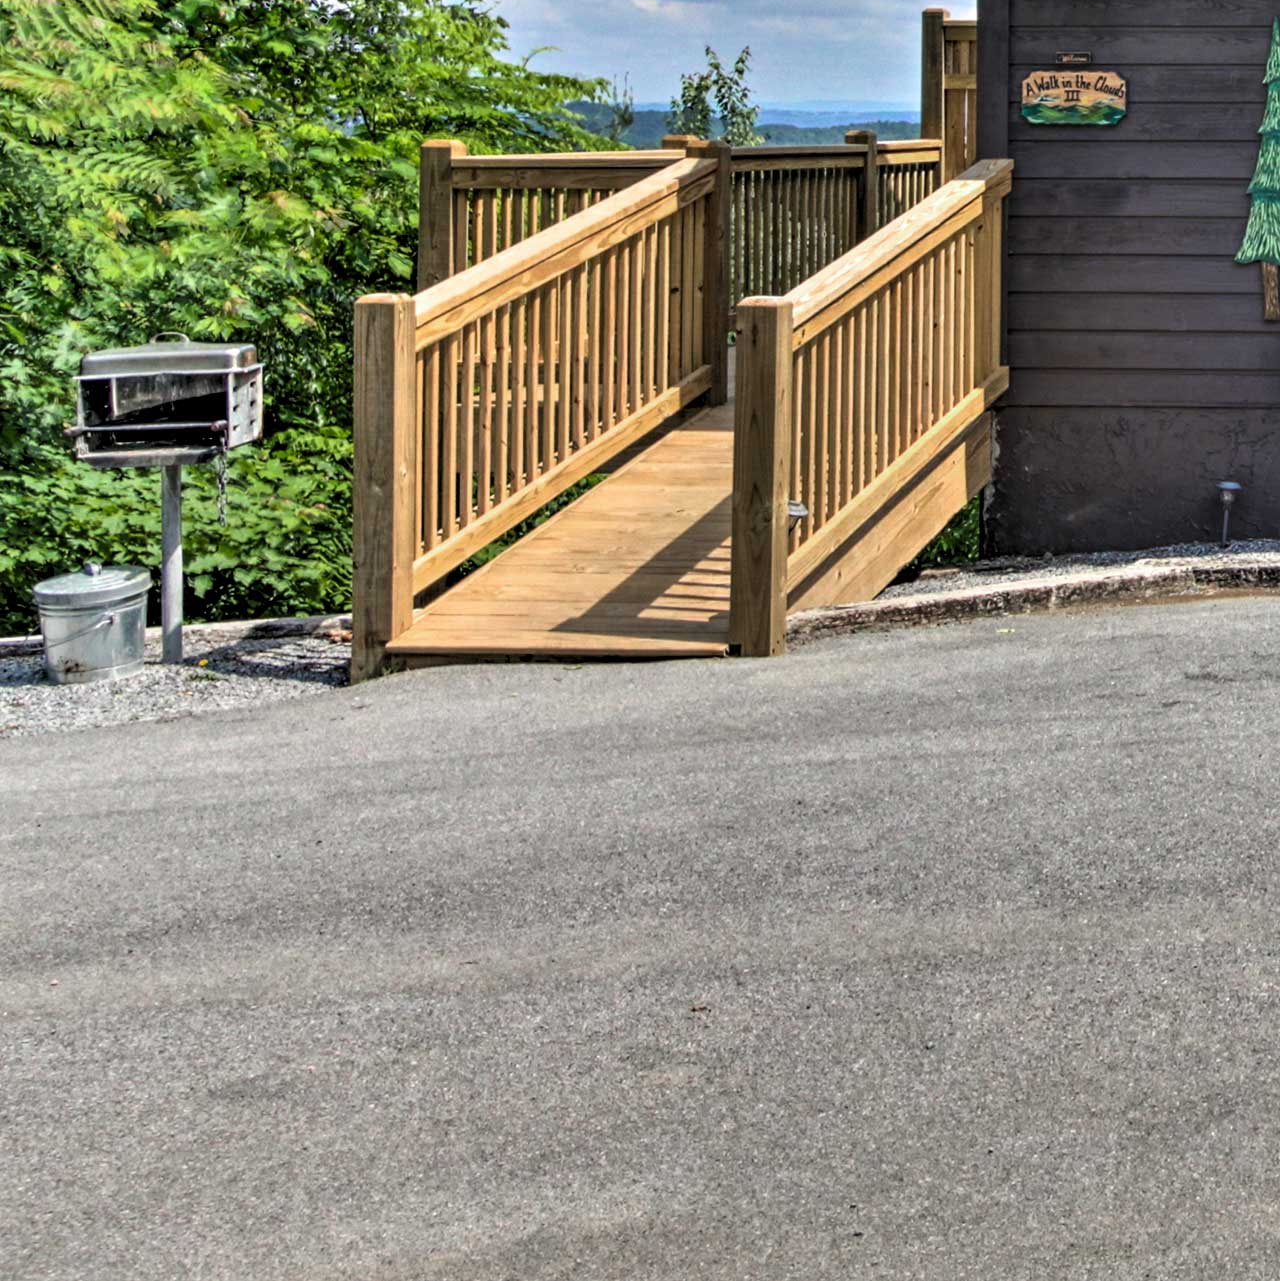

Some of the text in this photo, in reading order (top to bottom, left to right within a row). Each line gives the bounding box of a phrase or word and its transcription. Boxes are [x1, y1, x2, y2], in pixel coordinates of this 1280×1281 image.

[1026, 74, 1125, 98] A Walk in the Clouds
[1064, 90, 1081, 102] III
